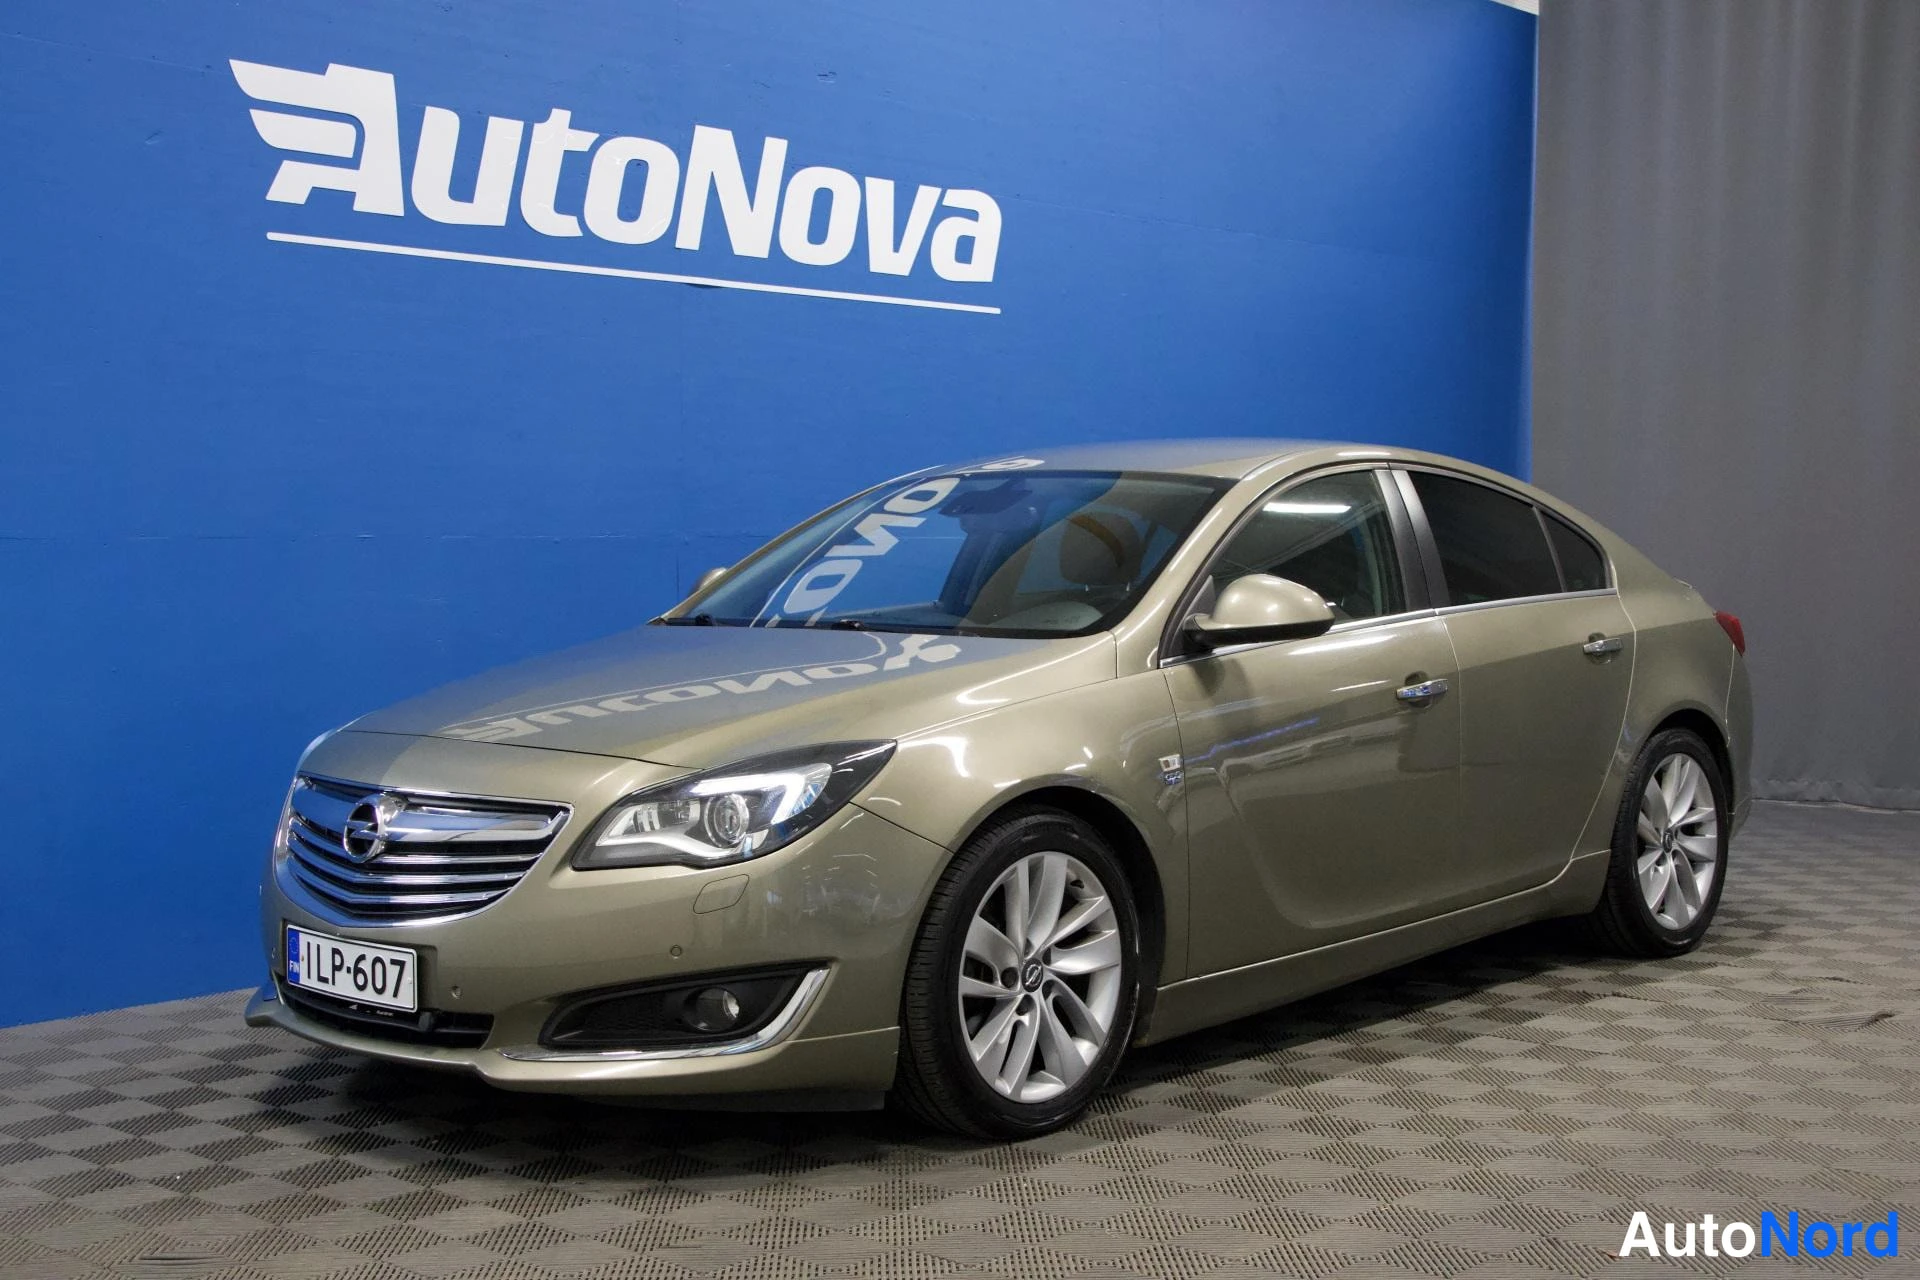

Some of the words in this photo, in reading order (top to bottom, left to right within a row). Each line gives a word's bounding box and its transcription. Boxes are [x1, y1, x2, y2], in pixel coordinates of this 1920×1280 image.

[229, 59, 1002, 283] AutoNova
[289, 960, 300, 974] FIN
[306, 941, 407, 998] ILP-607
